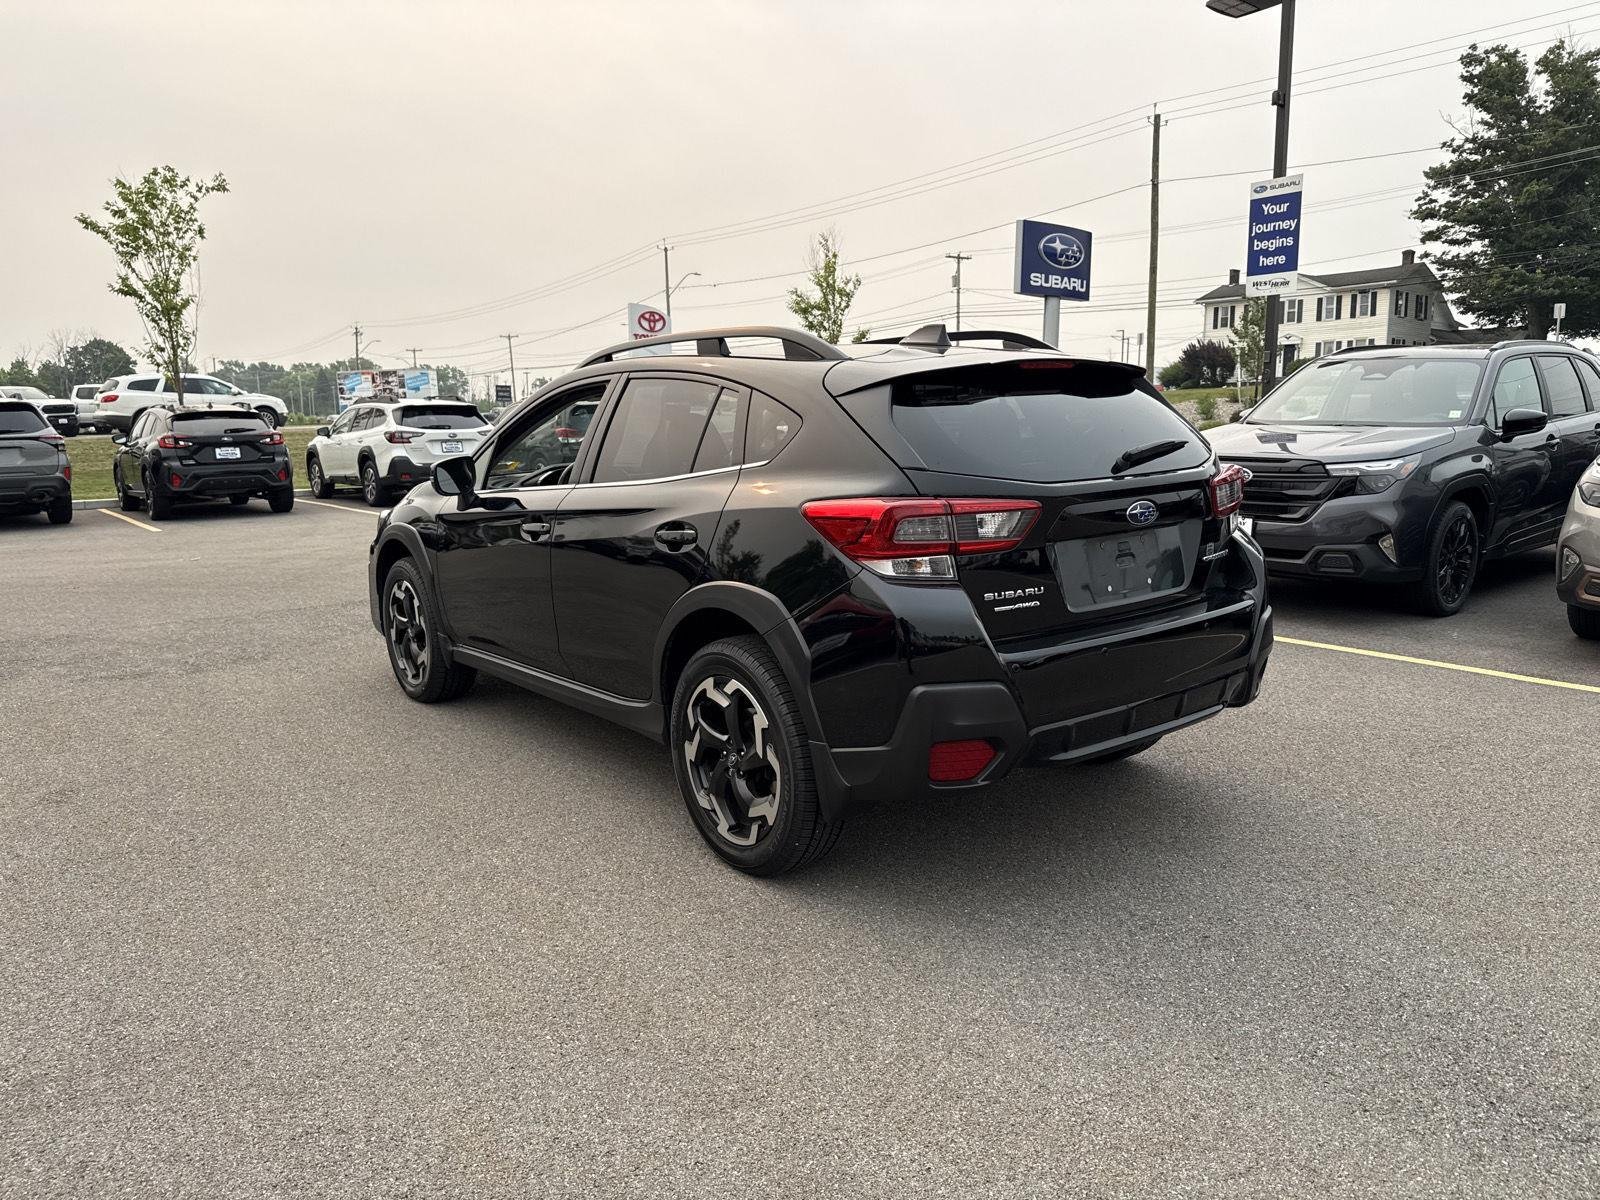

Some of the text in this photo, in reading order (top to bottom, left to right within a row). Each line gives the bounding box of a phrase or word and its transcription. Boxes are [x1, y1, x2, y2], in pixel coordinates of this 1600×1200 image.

[1269, 180, 1300, 190] SUBARU
[1262, 202, 1289, 215] Your
[1252, 218, 1297, 236] journey
[1253, 236, 1293, 251] begins
[1259, 255, 1285, 266] here
[1030, 273, 1086, 291] SUBARU
[984, 586, 1044, 600] SUBARU
